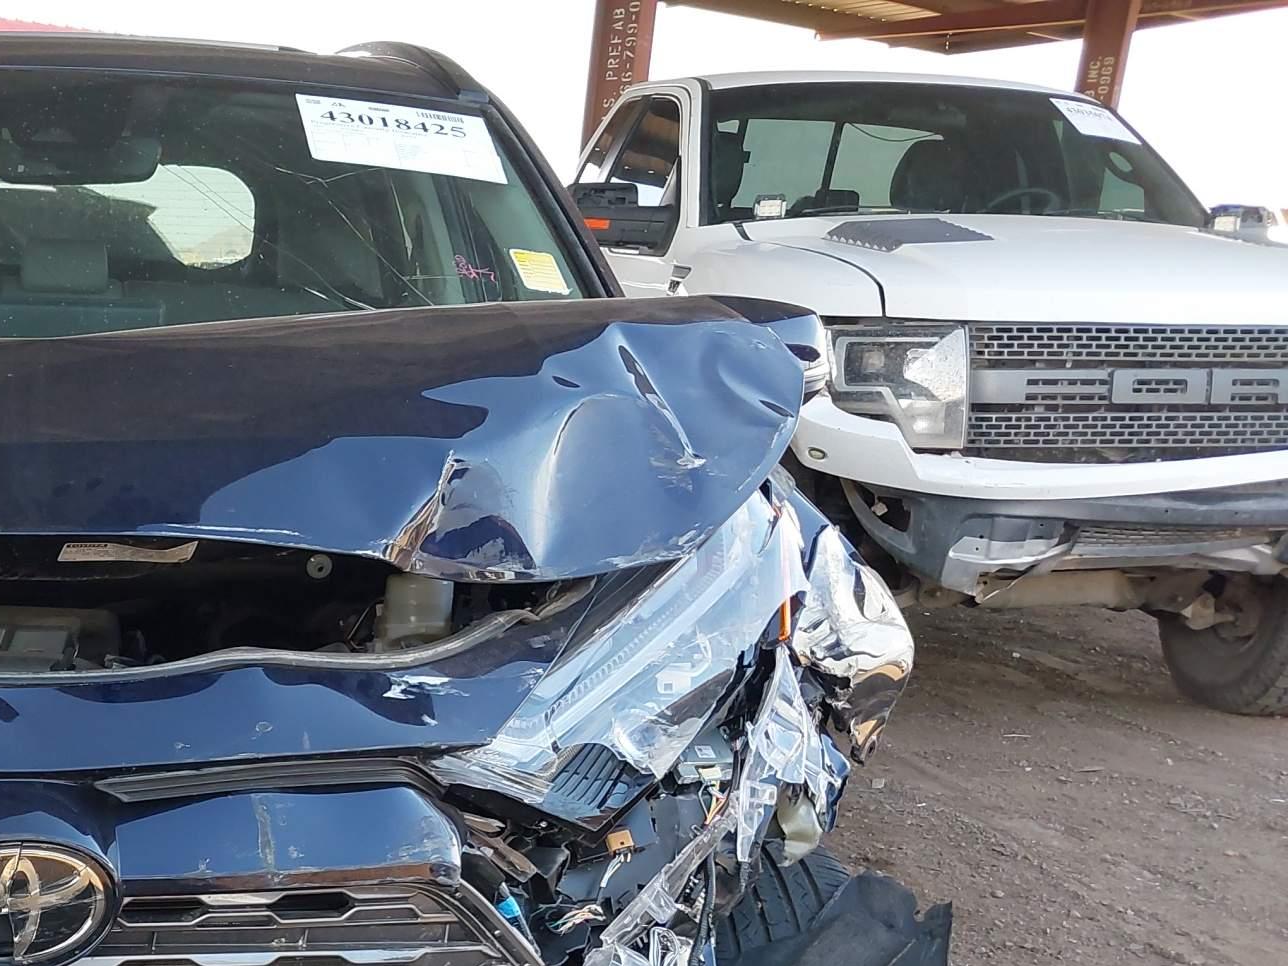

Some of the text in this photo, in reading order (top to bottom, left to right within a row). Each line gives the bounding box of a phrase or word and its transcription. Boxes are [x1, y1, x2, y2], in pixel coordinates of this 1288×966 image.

[605, 8, 625, 81] PREFAB
[1087, 56, 1102, 82] INC.
[320, 110, 467, 138] 43018425
